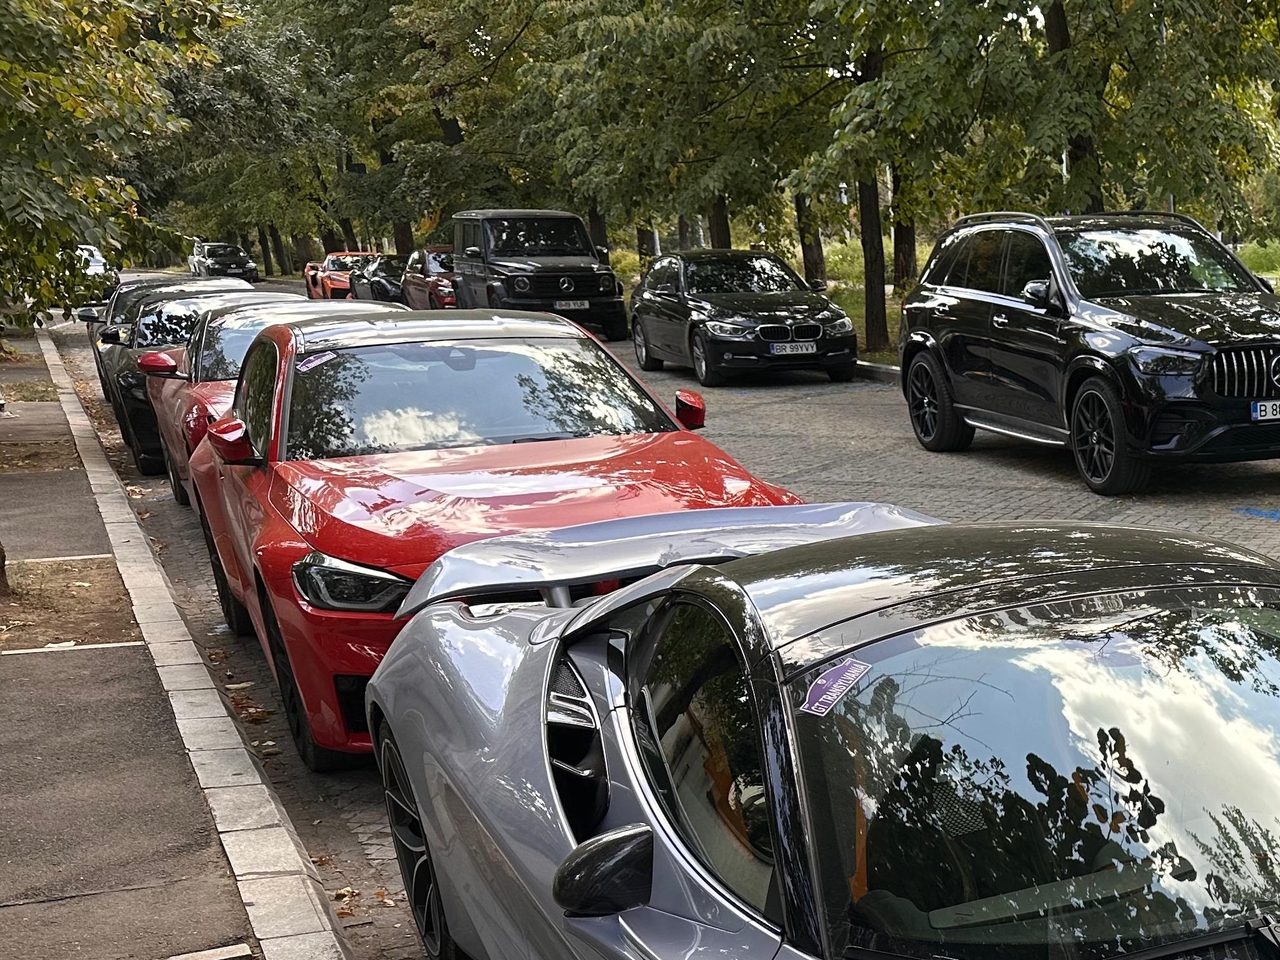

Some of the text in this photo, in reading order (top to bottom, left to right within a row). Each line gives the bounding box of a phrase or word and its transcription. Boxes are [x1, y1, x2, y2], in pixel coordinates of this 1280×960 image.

[775, 344, 787, 353] BR
[1260, 404, 1267, 417] B
[819, 663, 868, 704] TRANSYLVANIA
[811, 702, 828, 713] GT
